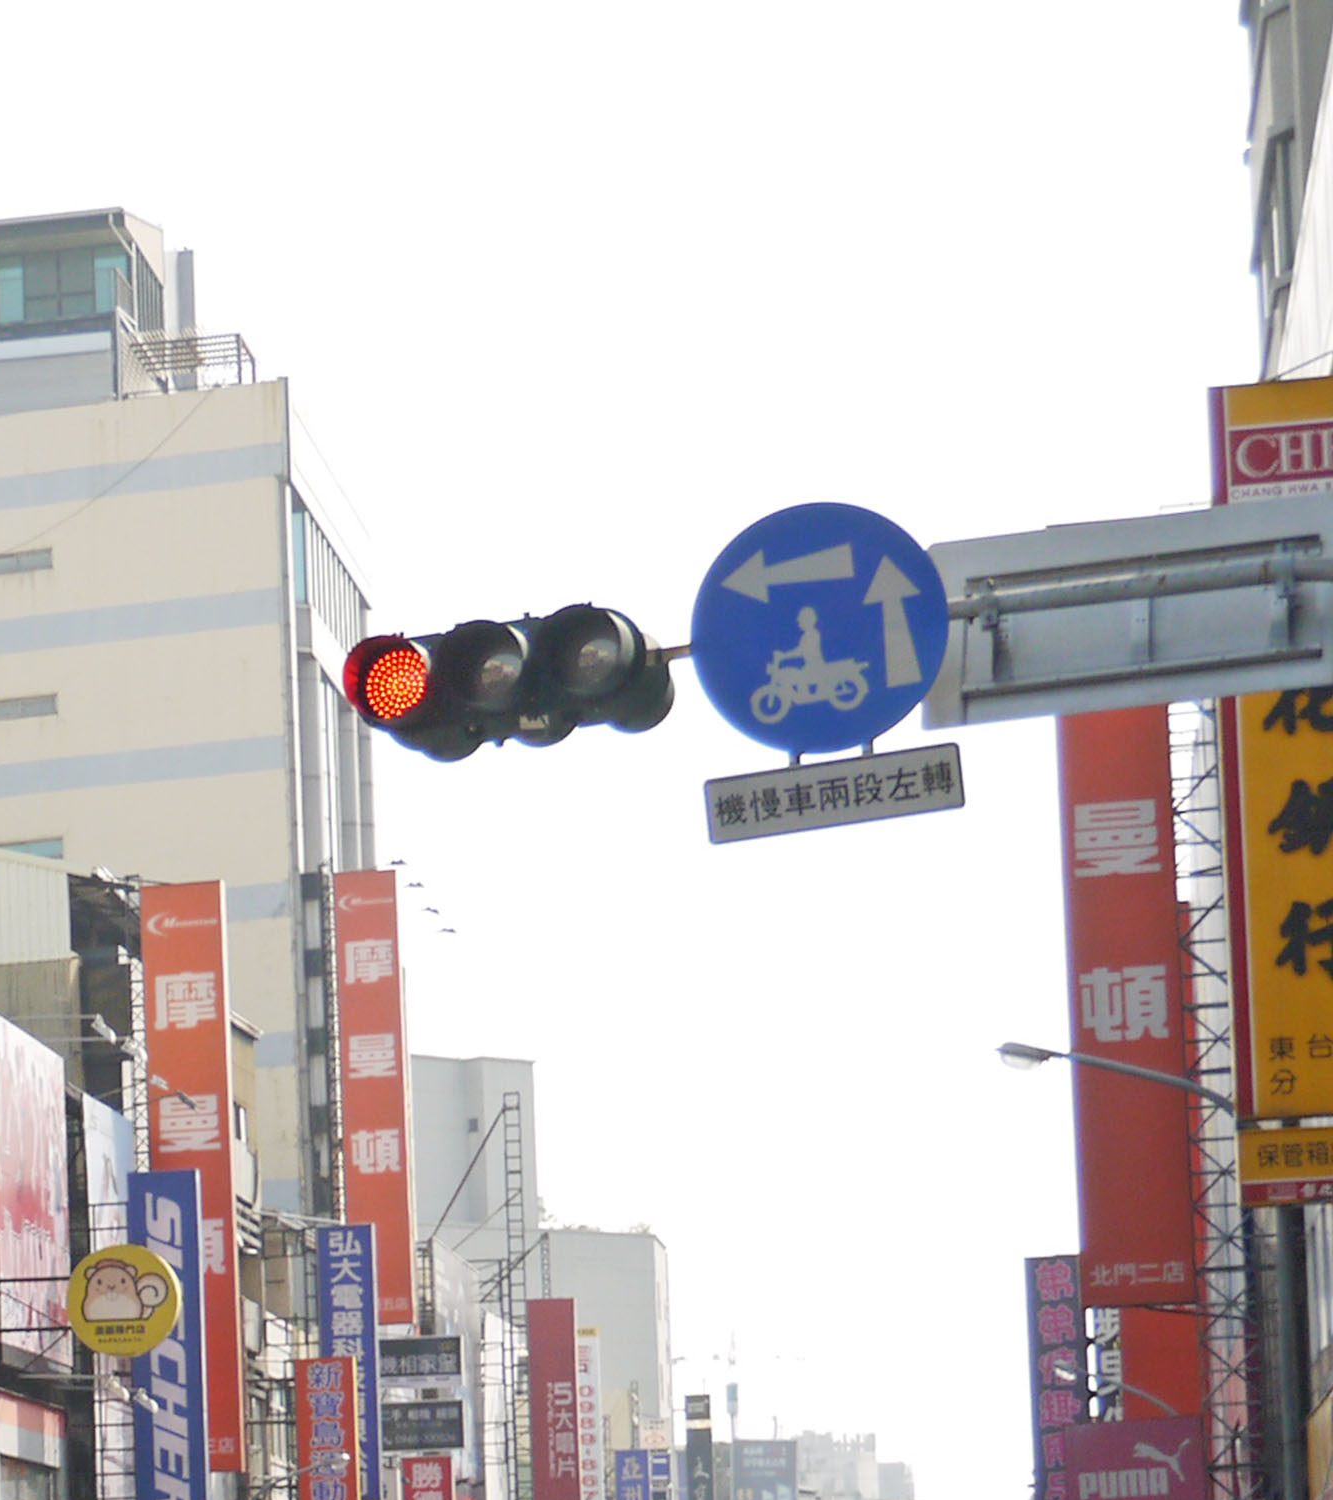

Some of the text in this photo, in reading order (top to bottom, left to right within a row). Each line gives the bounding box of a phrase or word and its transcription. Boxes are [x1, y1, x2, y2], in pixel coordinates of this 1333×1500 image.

[714, 761, 956, 826] 機慢車兩段左轉
[344, 939, 403, 1175] 摩曼頓
[1079, 1467, 1170, 1500] PUMA
